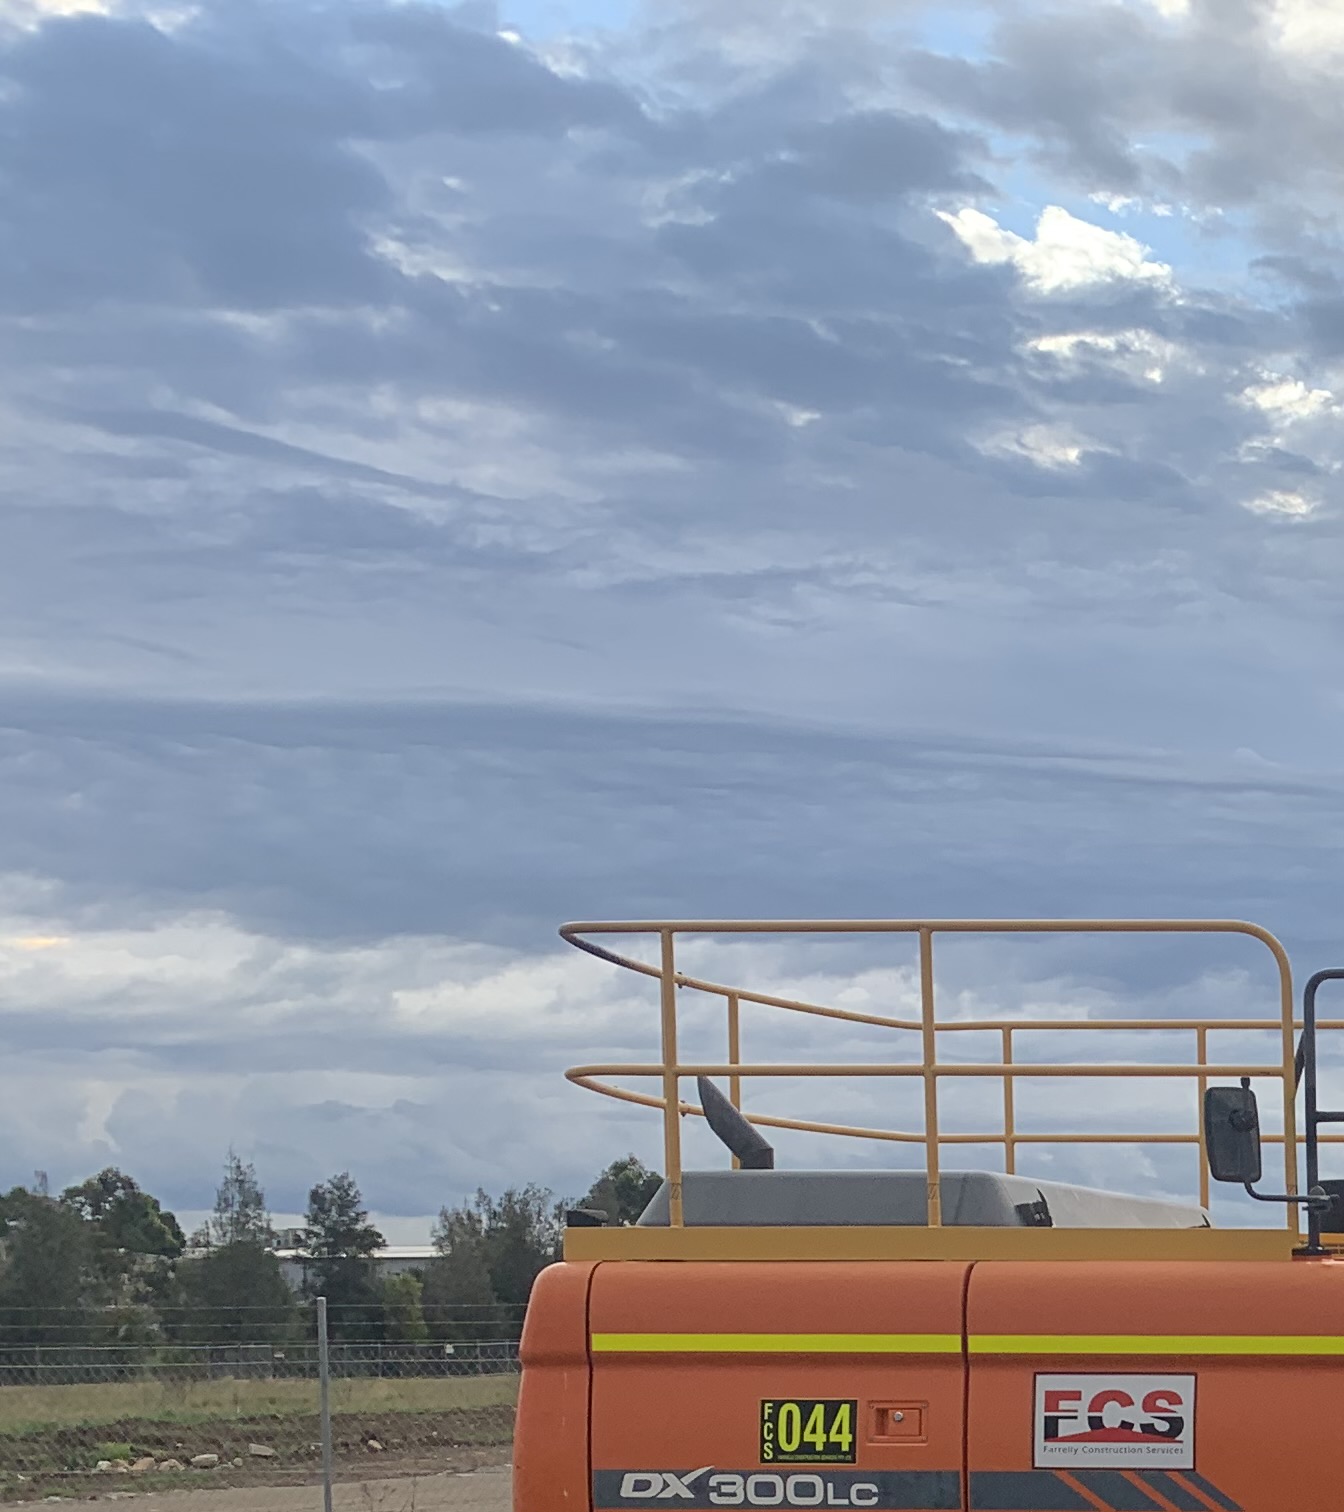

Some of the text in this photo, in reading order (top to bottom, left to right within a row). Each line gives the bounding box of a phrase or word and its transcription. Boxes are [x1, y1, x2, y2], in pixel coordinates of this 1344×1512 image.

[778, 1402, 852, 1452] 044
[1044, 1390, 1184, 1442] FCS
[1043, 1445, 1184, 1456] Farrelly Construction Services
